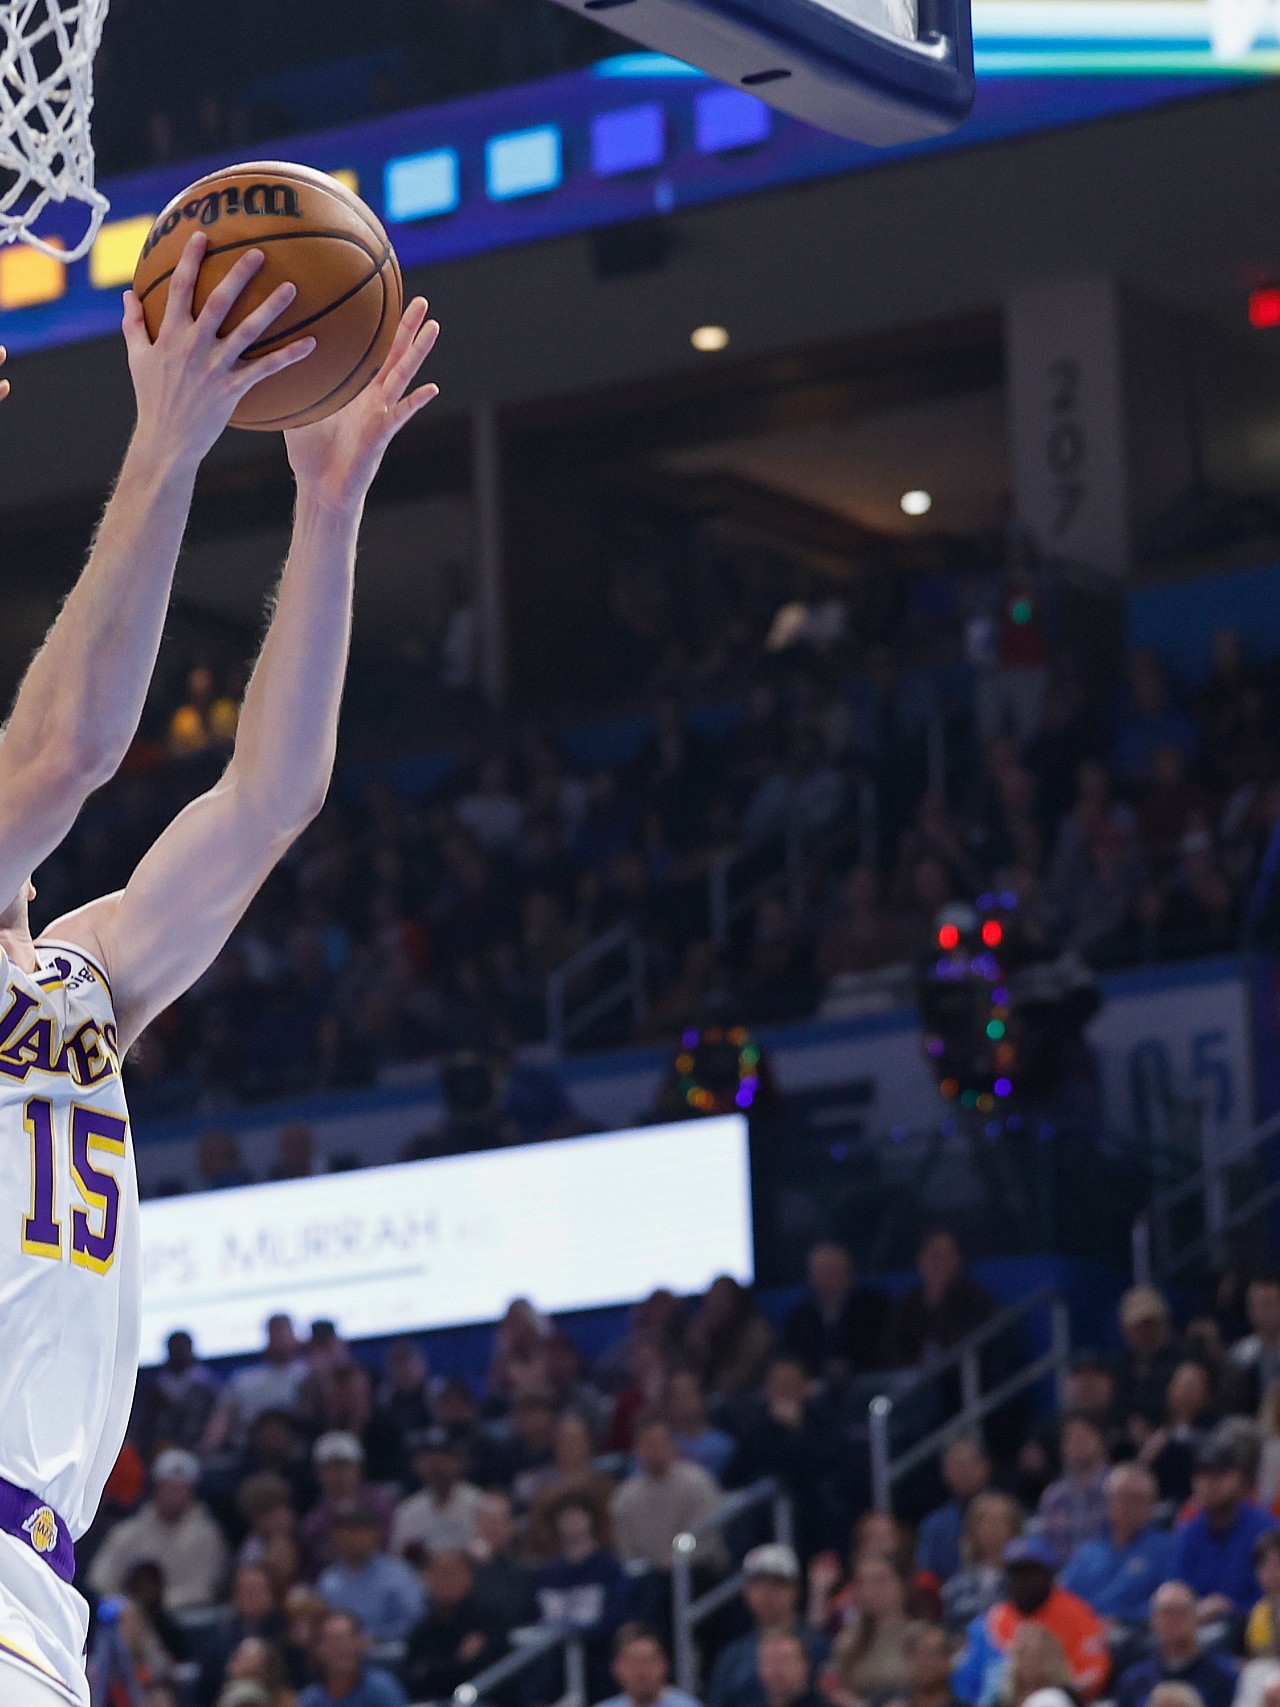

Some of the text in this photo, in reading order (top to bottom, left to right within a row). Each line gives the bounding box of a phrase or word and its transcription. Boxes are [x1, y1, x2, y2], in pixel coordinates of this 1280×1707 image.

[1047, 354, 1086, 538] 207
[22, 1095, 129, 1276] 15
[219, 1208, 442, 1278] MURRAH
